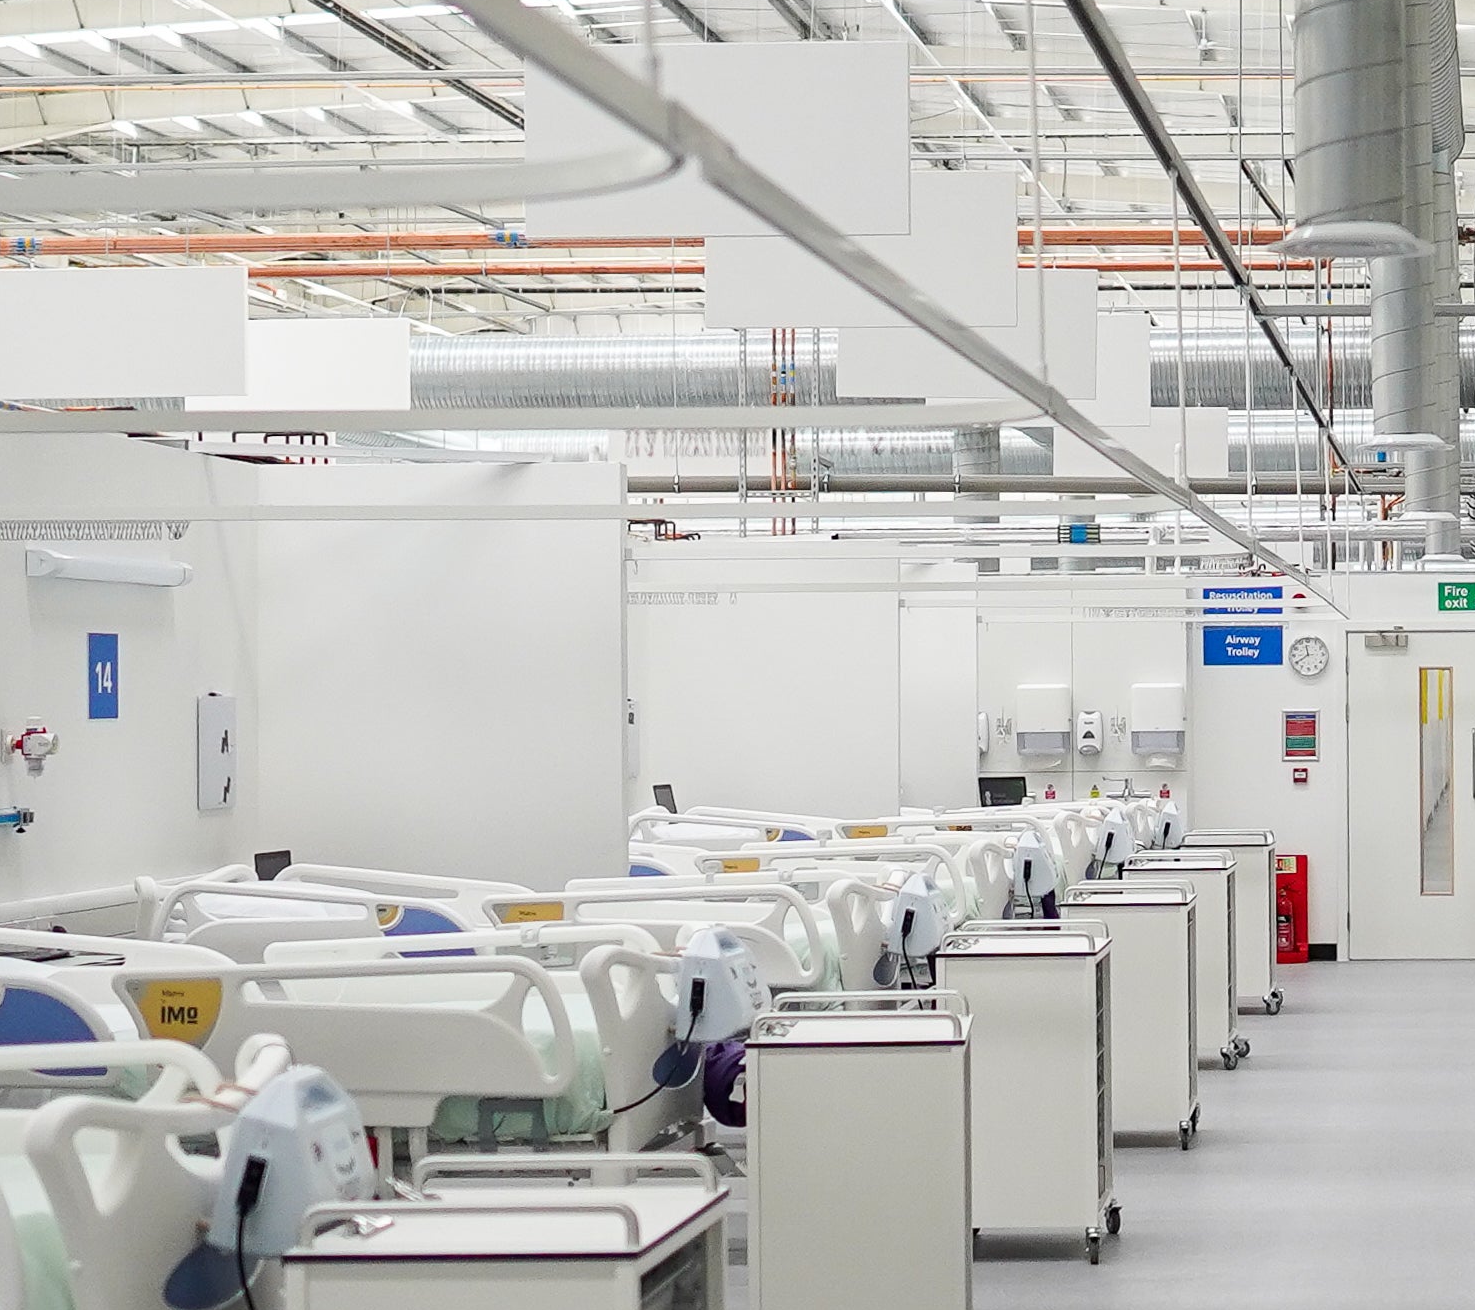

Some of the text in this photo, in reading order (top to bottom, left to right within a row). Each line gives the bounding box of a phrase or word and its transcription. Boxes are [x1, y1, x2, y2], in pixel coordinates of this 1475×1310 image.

[1208, 591, 1273, 600] Resuscitation
[1444, 585, 1468, 597] Fire
[1444, 598, 1468, 609] exit
[1225, 635, 1261, 646] Airway
[1226, 647, 1260, 658] Trolley
[95, 661, 113, 694] 14
